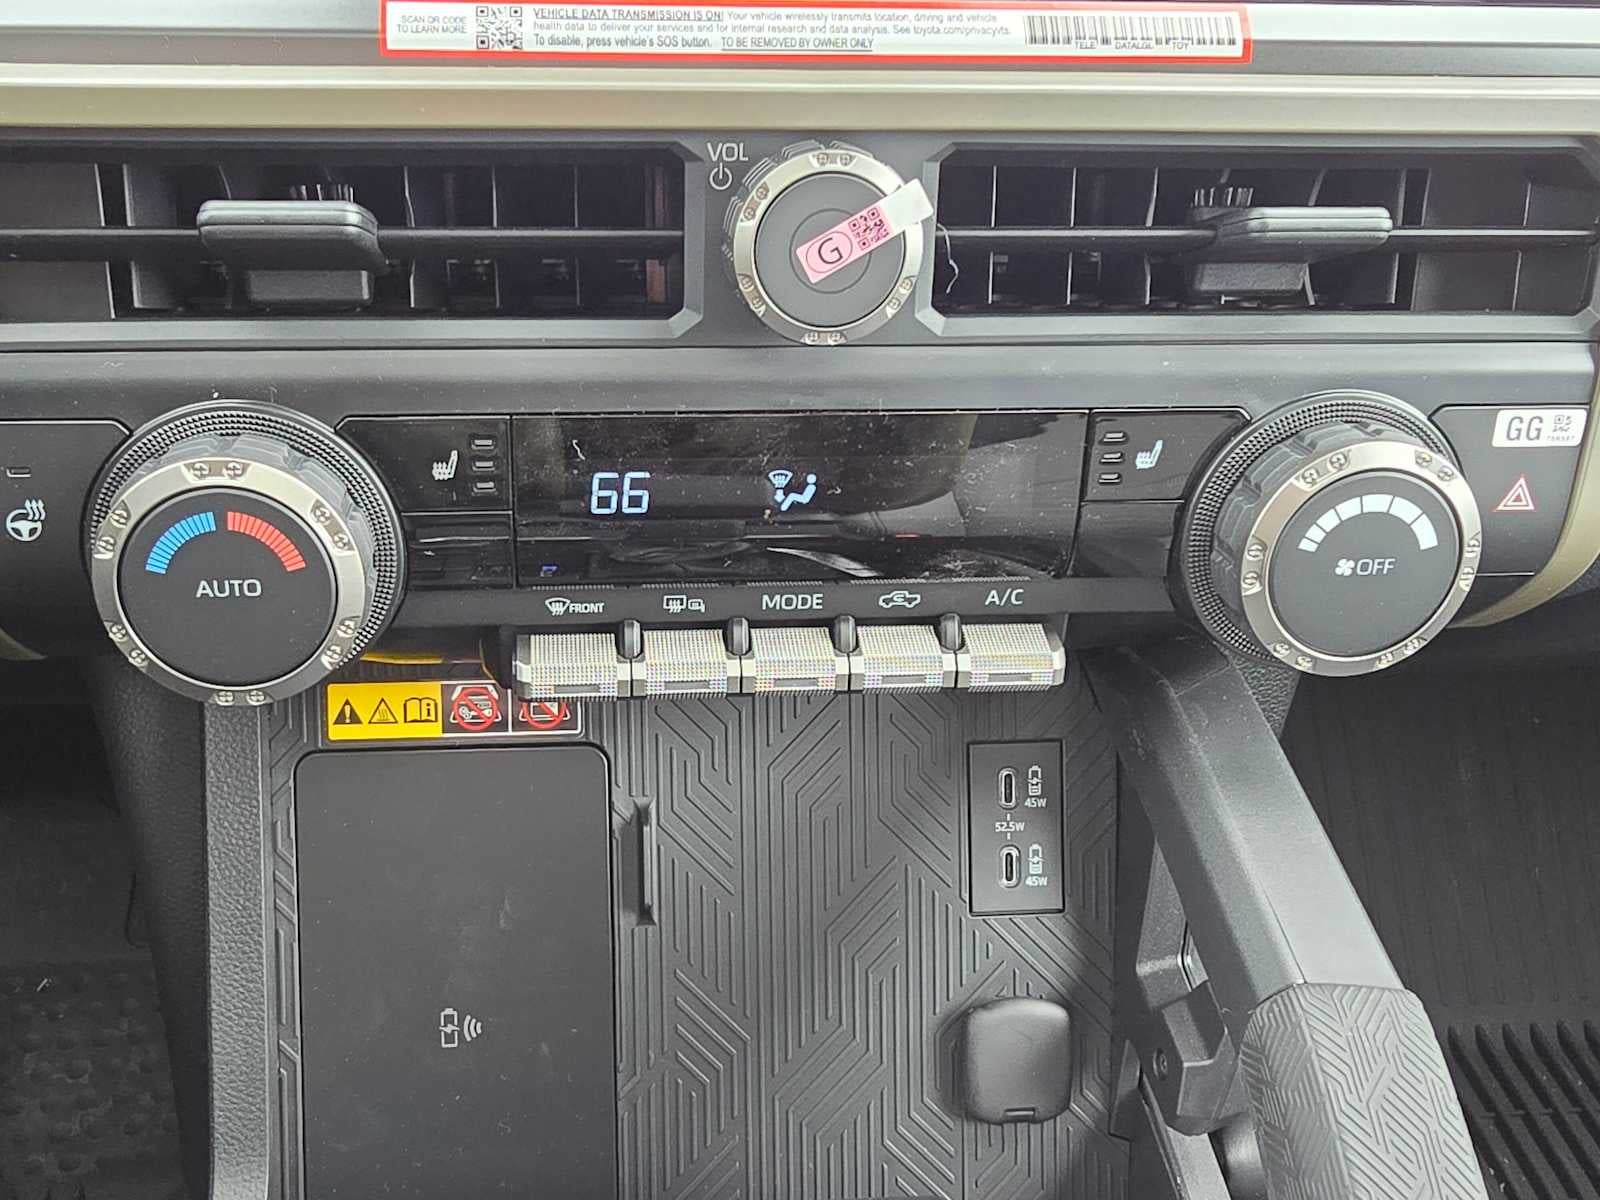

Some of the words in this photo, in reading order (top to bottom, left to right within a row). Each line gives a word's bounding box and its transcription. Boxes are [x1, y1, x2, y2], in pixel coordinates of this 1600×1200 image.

[401, 15, 425, 24] SCAN
[442, 16, 467, 24] CODE
[533, 8, 578, 19] VEHICLE
[581, 8, 610, 20] DATA
[612, 9, 691, 21] TRANSMISSION
[693, 10, 704, 21] IS
[727, 11, 747, 21] Your
[751, 11, 783, 21] vehicle
[785, 11, 829, 23] wirelessly
[831, 12, 873, 22] transmits
[914, 13, 944, 24] driving
[946, 13, 963, 22] and
[966, 13, 997, 23] vehicle
[396, 24, 409, 33] TO
[411, 24, 440, 34] LEARN
[441, 24, 468, 34] MORE
[533, 20, 562, 31] health
[564, 21, 585, 31] data
[588, 21, 598, 31] to
[600, 21, 631, 32] deliver
[633, 23, 654, 34] your
[656, 22, 695, 33] services
[697, 23, 714, 33] and
[716, 23, 729, 33] for
[731, 23, 765, 33] internal
[767, 24, 807, 33] research
[810, 24, 827, 34] and
[830, 24, 849, 34] data
[851, 24, 889, 36] analysis.
[892, 25, 911, 34] See
[534, 33, 546, 46] To
[547, 34, 584, 48] disable,
[586, 35, 613, 49] press
[614, 35, 655, 47] vehicle's
[656, 35, 680, 47] SOS
[681, 36, 713, 48] button.
[721, 36, 735, 48] TO
[736, 36, 749, 48] BE
[750, 36, 797, 48] REMOVED
[798, 37, 811, 48] BY
[812, 37, 849, 49] OWNER
[850, 37, 875, 49] ONLY
[706, 142, 749, 162] VOL
[817, 236, 844, 265] G
[1506, 415, 1544, 441] GG
[590, 471, 652, 515] 66
[1356, 558, 1396, 576] OFF
[196, 579, 262, 598] AUTO
[762, 593, 824, 610] MODE
[985, 588, 1024, 606] A/C
[569, 602, 605, 614] FRONT
[1024, 797, 1047, 809] 45W
[994, 821, 1025, 833] 52.5W
[1025, 875, 1049, 887] 45W
